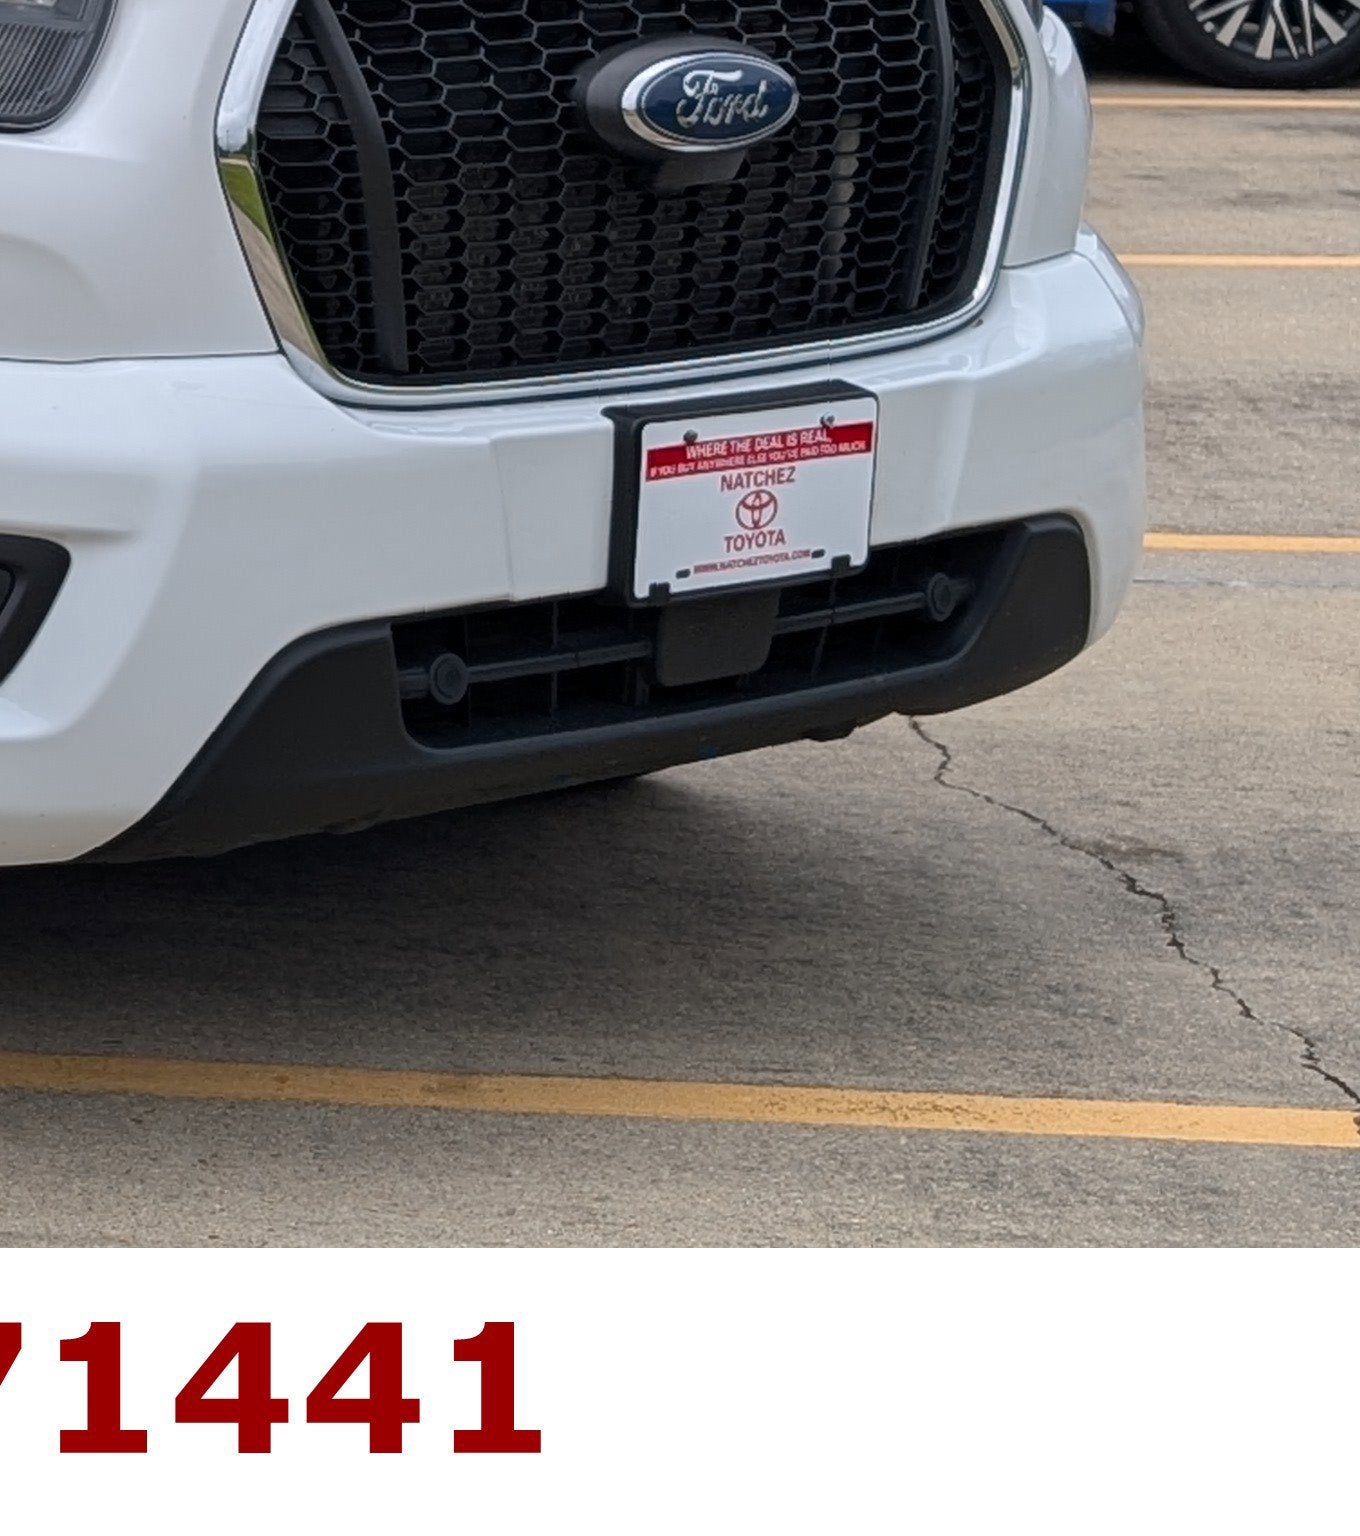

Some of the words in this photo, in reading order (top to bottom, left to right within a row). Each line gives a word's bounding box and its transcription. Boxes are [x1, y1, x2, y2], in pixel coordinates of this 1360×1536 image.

[675, 69, 770, 129] Ford
[685, 440, 728, 460] WHERE
[729, 437, 752, 454] THE
[754, 435, 784, 452] DEAL
[786, 432, 798, 447] IS
[720, 466, 796, 492] NATCHEZ
[724, 528, 786, 554] TOYOTA
